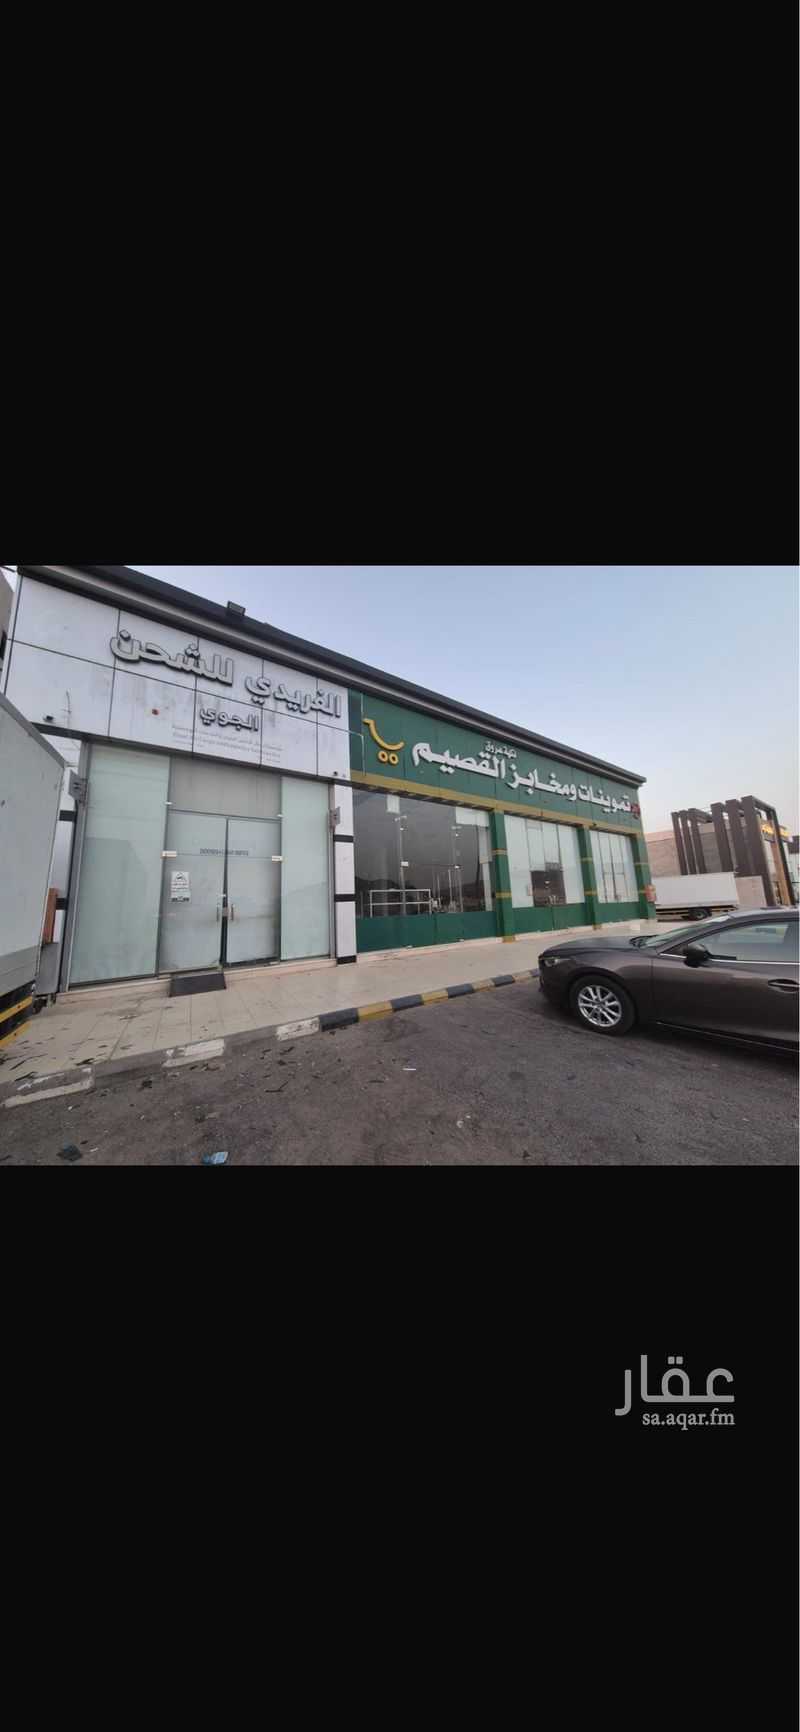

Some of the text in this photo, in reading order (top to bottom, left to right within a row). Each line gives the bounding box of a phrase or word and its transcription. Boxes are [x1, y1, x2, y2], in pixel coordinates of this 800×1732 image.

[110, 629, 341, 718] الفريدي للشحن
[200, 707, 259, 732] الجوي
[412, 742, 506, 779] القصيم
[506, 763, 577, 801] ومخابز
[578, 785, 631, 814] تموينات
